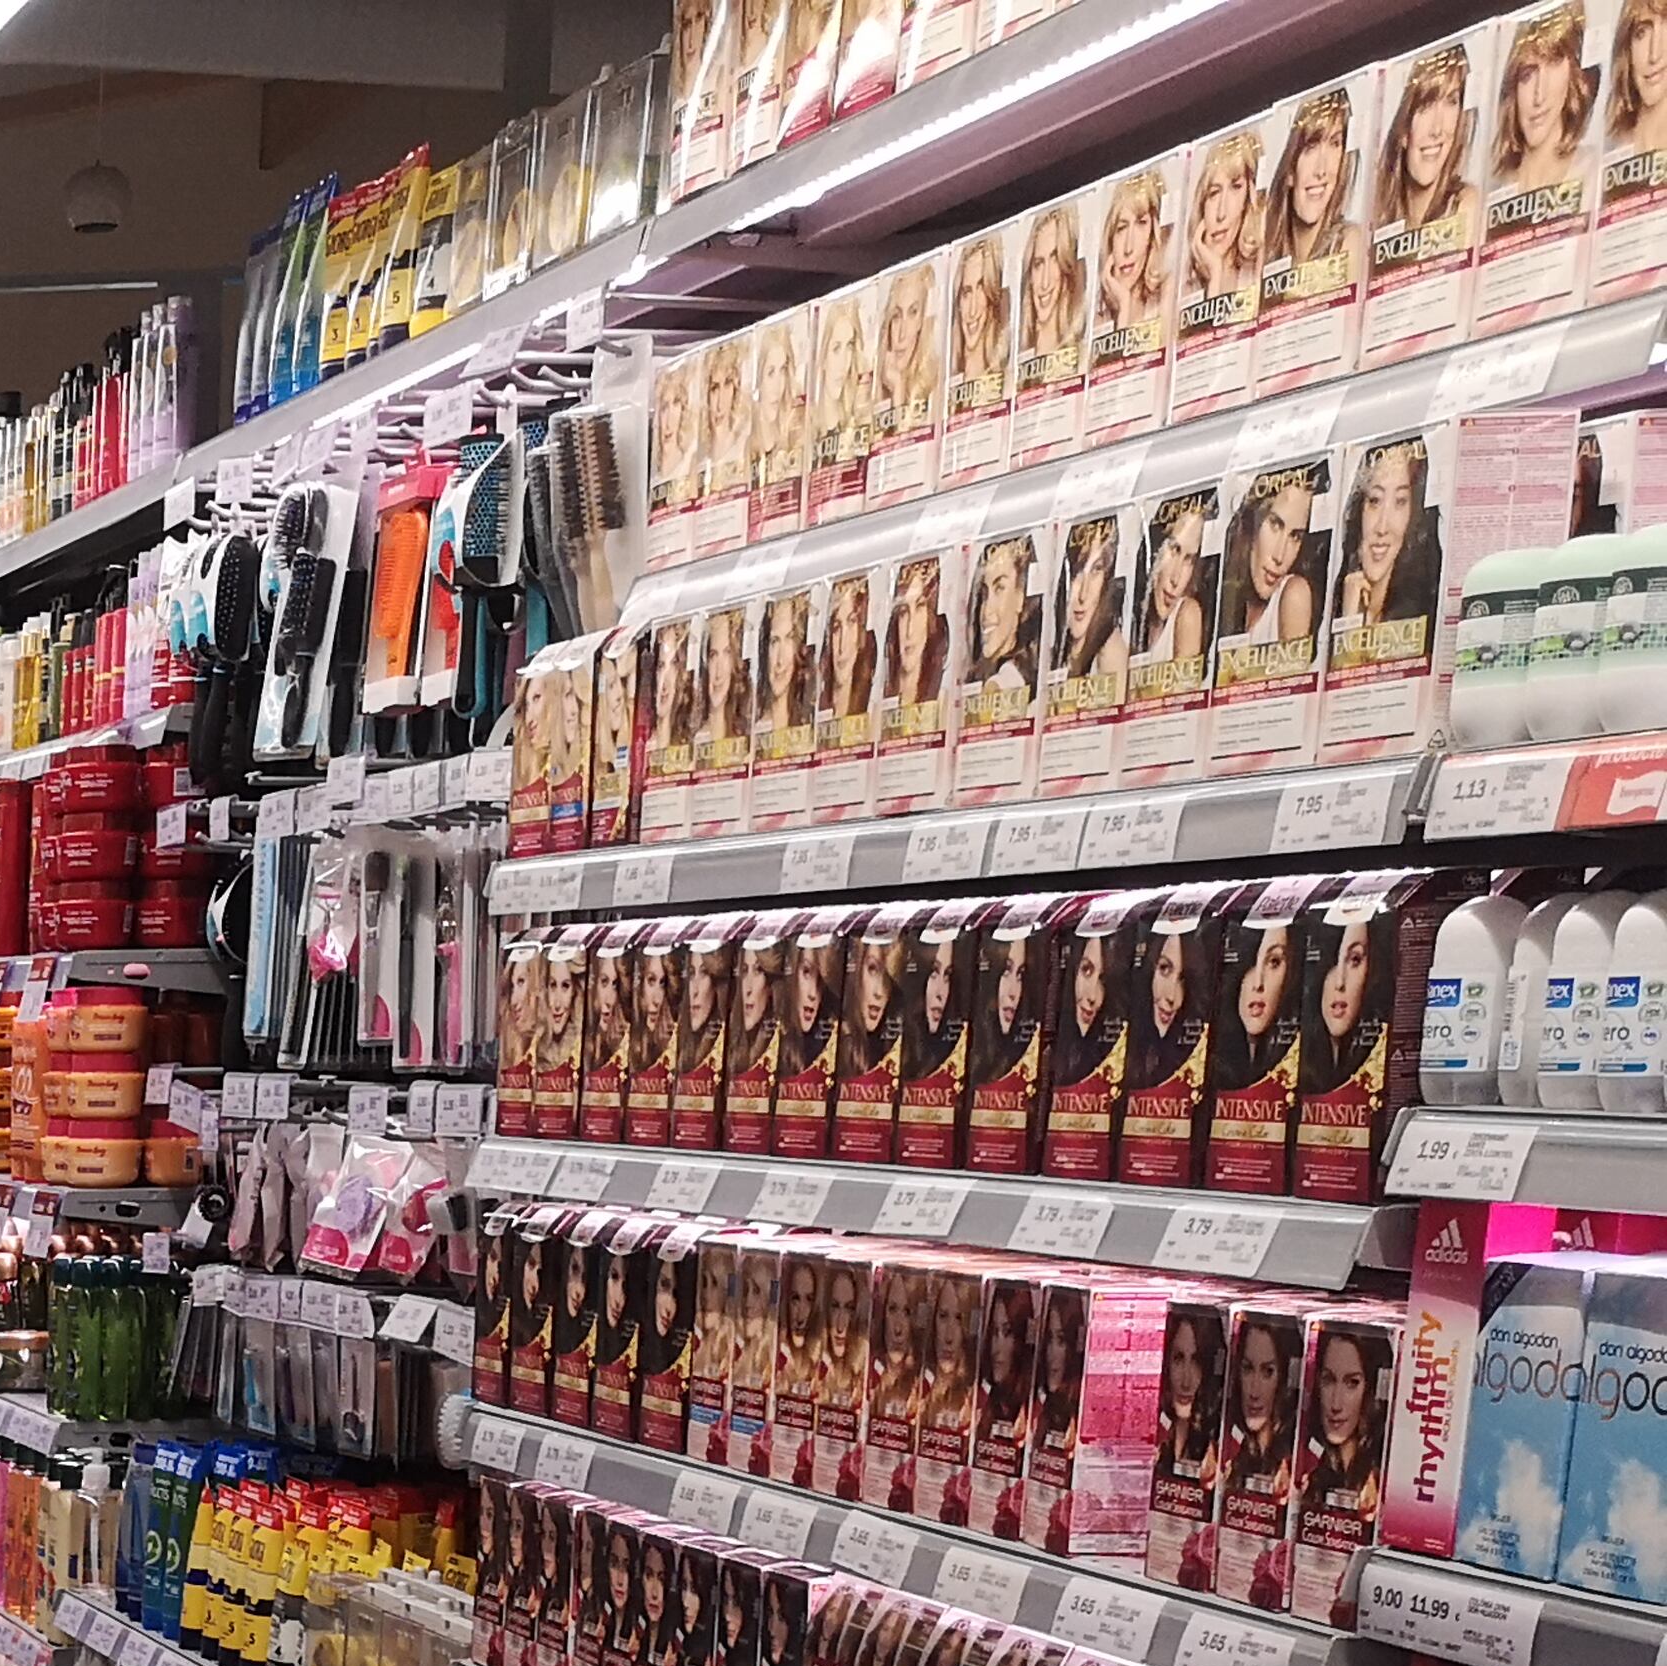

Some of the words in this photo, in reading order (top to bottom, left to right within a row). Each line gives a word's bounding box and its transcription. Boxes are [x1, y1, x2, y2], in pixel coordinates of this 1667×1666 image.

[1294, 795, 1323, 816] 7,95
[1053, 1091, 1107, 1114] INTENSIVE
[1128, 1096, 1190, 1118] INTENSIVE
[1216, 1097, 1284, 1121] INTENSIVE
[1302, 1100, 1367, 1126] INTENSIVE
[1417, 1139, 1450, 1162] 1,99
[1183, 1218, 1212, 1236] 3,79
[1425, 1248, 1468, 1264] adidas
[1490, 1327, 1510, 1345] don
[1512, 1328, 1558, 1349] algodon
[1599, 1341, 1622, 1358] don
[1406, 1310, 1443, 1414] fruity
[1415, 1354, 1451, 1504] rhythm
[978, 1439, 1015, 1461] GARNIER
[1156, 1480, 1202, 1502] GARNIER
[1226, 1495, 1275, 1518] GARNIER
[1304, 1510, 1362, 1537] GARNIER
[1070, 1595, 1095, 1615] 3,65
[1373, 1585, 1402, 1609] 9,00
[1409, 1594, 1450, 1620] 11,99
[1198, 1629, 1225, 1653] 3,65
